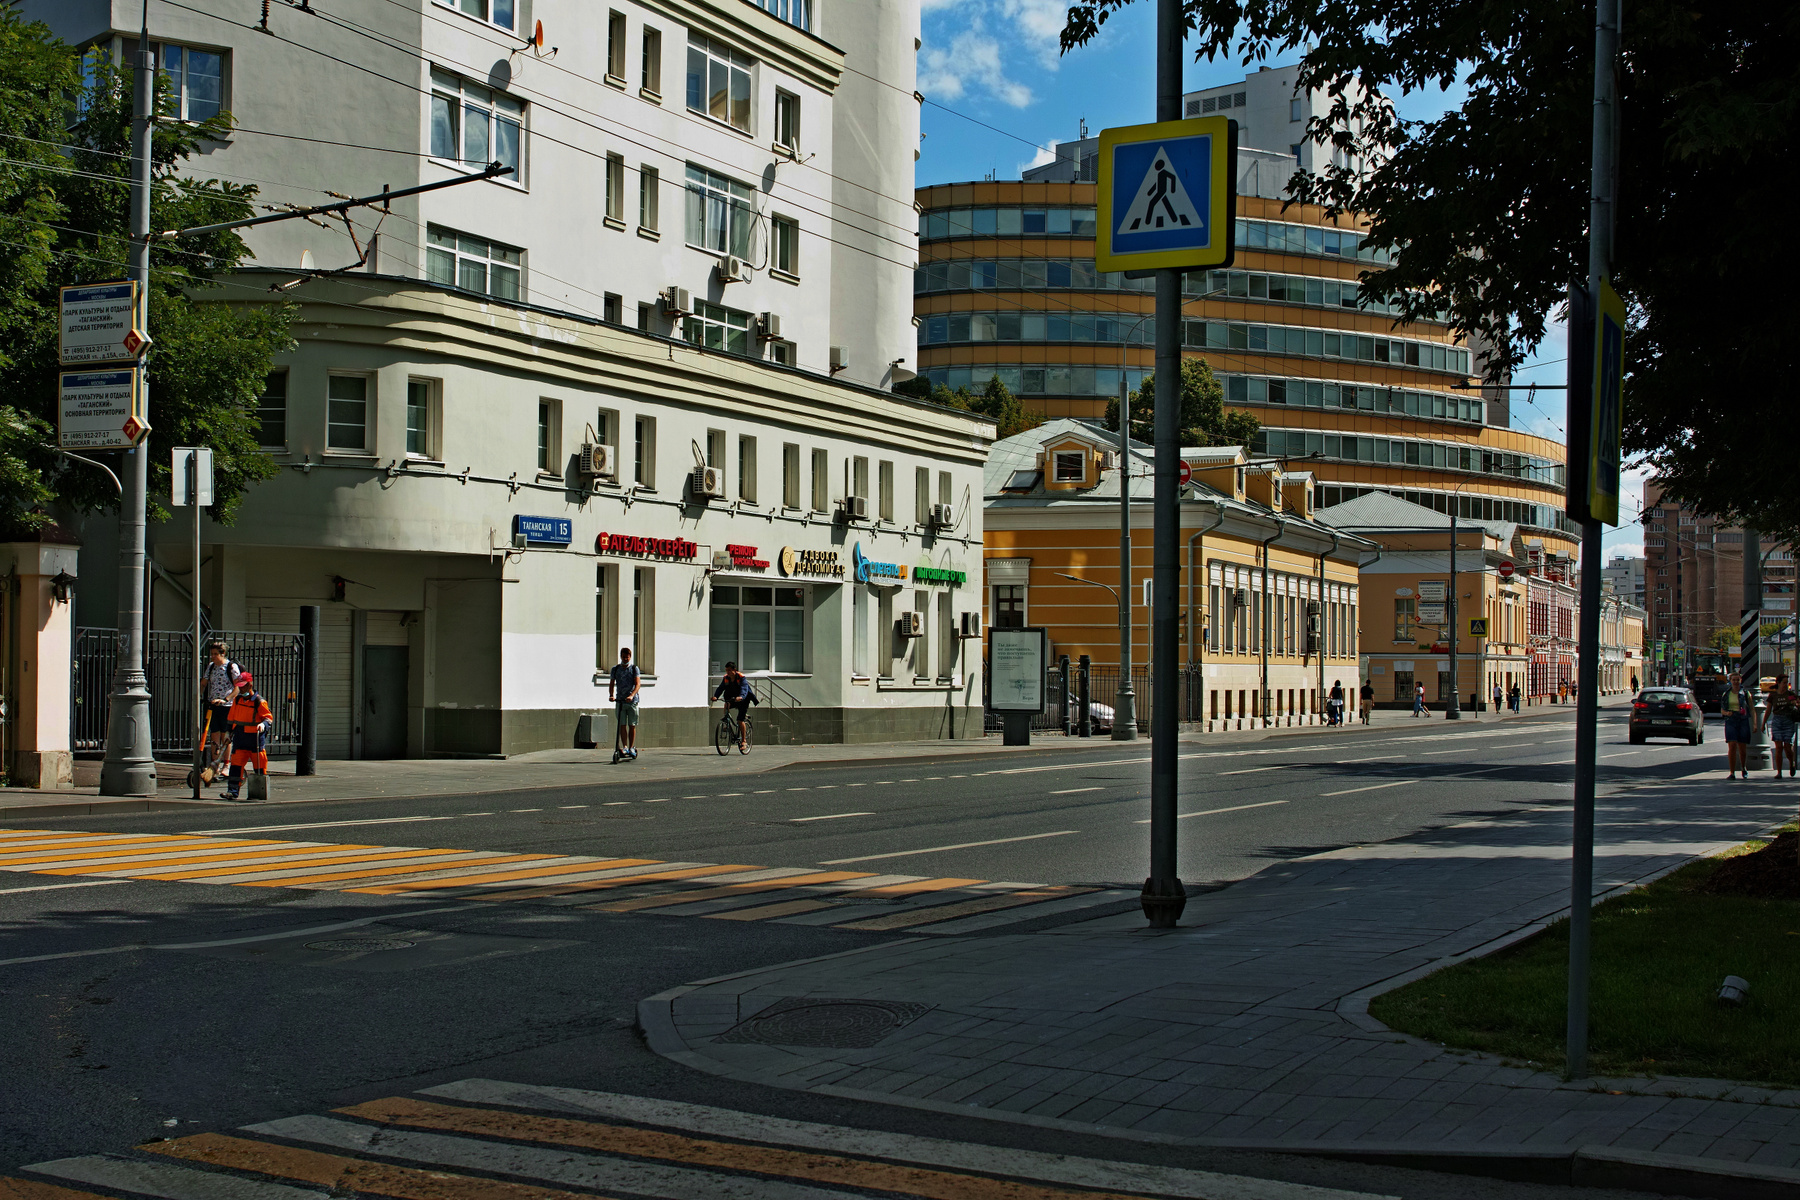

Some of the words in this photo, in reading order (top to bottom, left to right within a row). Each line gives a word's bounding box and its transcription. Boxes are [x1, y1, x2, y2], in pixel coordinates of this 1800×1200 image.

[79, 307, 105, 315] КУЛЬТУРЫ
[110, 305, 131, 313] ОТДЫХА
[79, 314, 113, 323] «ТАГАНСКИЙ»
[68, 325, 90, 333] ДЕТСКАЯ
[91, 322, 123, 331] ТЕРРИТОРИЯ
[62, 353, 90, 361] ТАГАНСКАЯ
[110, 391, 130, 399] ОТДЫХА
[78, 400, 112, 408] «ТАГАНСКИЙ»
[93, 408, 125, 416] ТЕРРИТОРИЯ
[522, 521, 552, 532] ТАГАНСКАЯ
[559, 523, 568, 536] 15
[610, 534, 649, 553] АТЕЛЬЕ
[649, 537, 658, 554] У
[658, 537, 697, 557] СЕРЁГИ
[729, 544, 758, 557] РЕМОНТ
[803, 550, 839, 561] АДВОКАТ
[753, 559, 770, 568] ЧАСОВ
[916, 567, 950, 581] ВЫГОДНЫЕ
